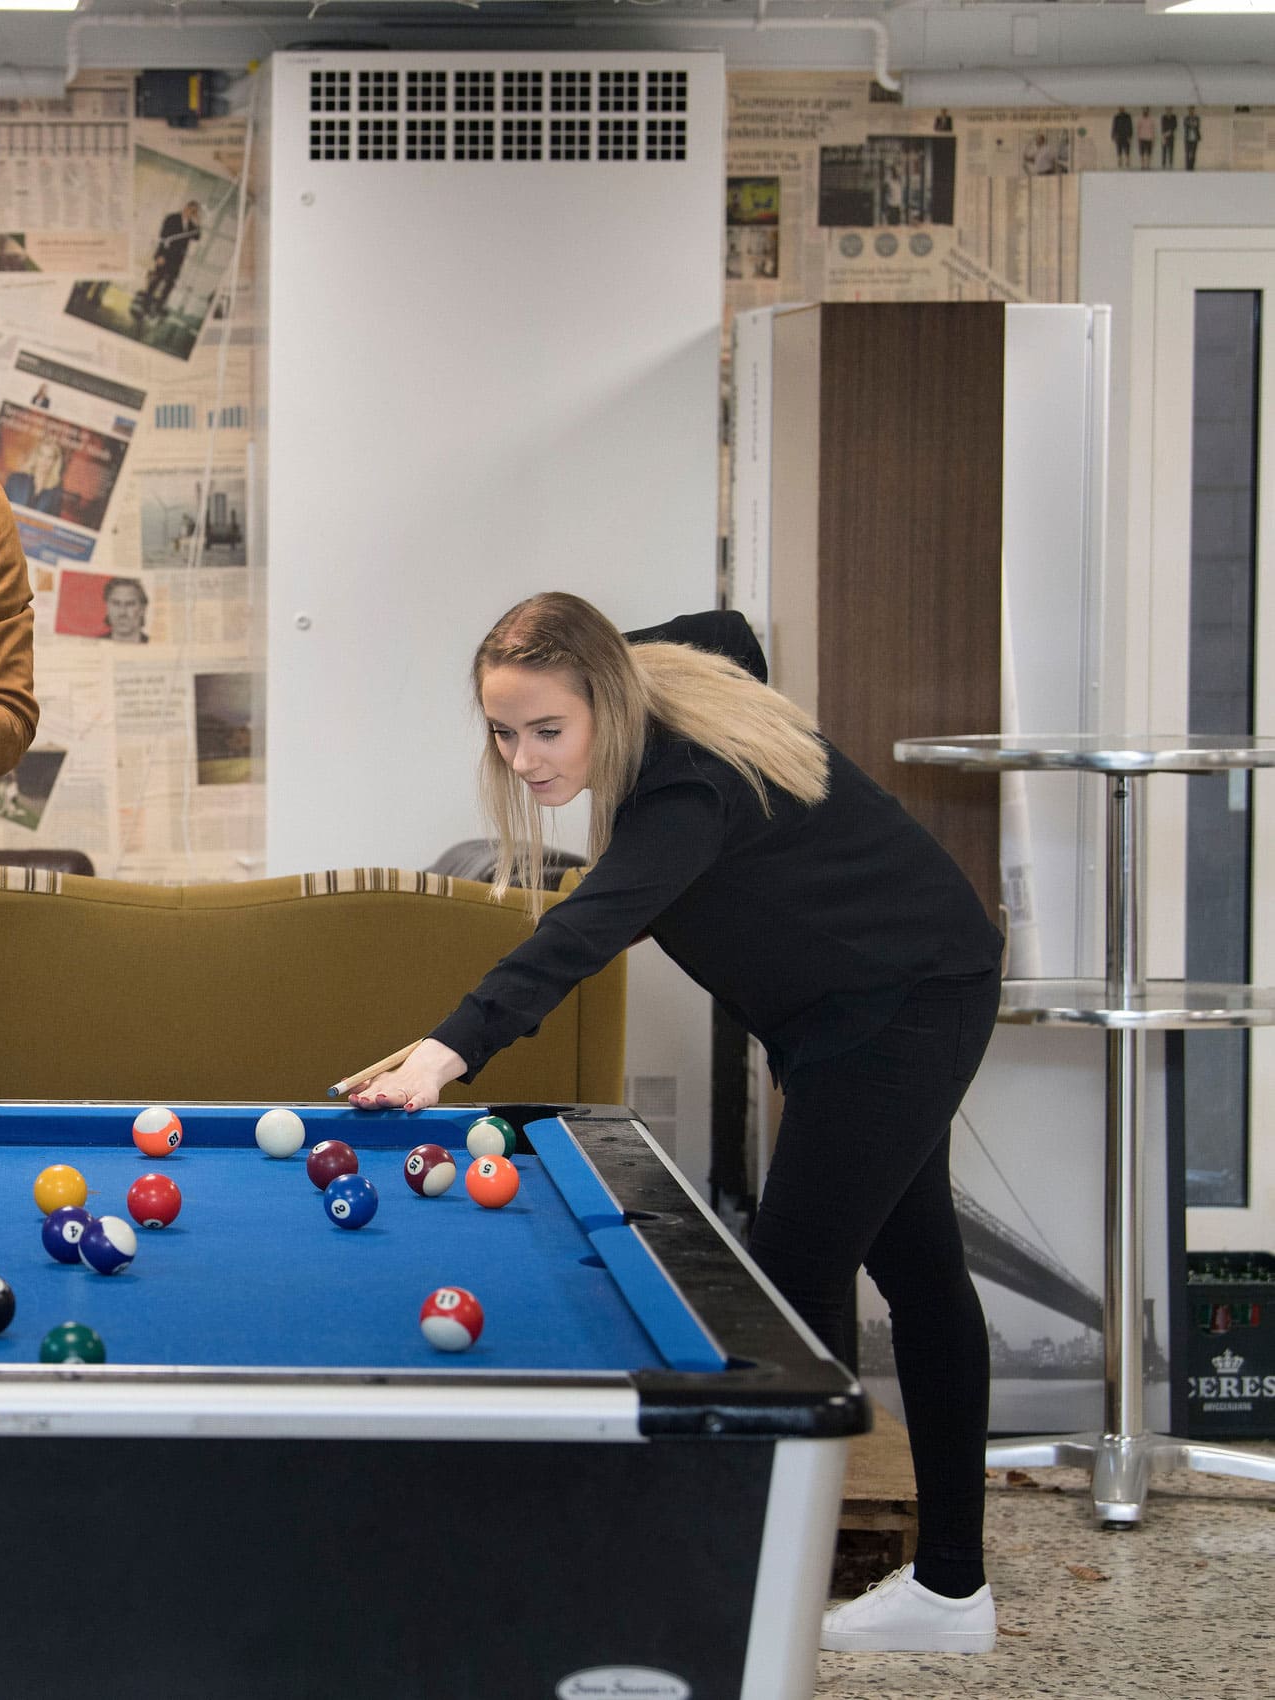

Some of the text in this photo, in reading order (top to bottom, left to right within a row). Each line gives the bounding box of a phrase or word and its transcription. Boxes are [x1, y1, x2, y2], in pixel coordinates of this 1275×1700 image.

[169, 1131, 179, 1146] 13
[409, 1157, 421, 1172] 15
[482, 1164, 492, 1174] 5
[334, 1204, 346, 1215] 2
[70, 1225, 79, 1238] 4
